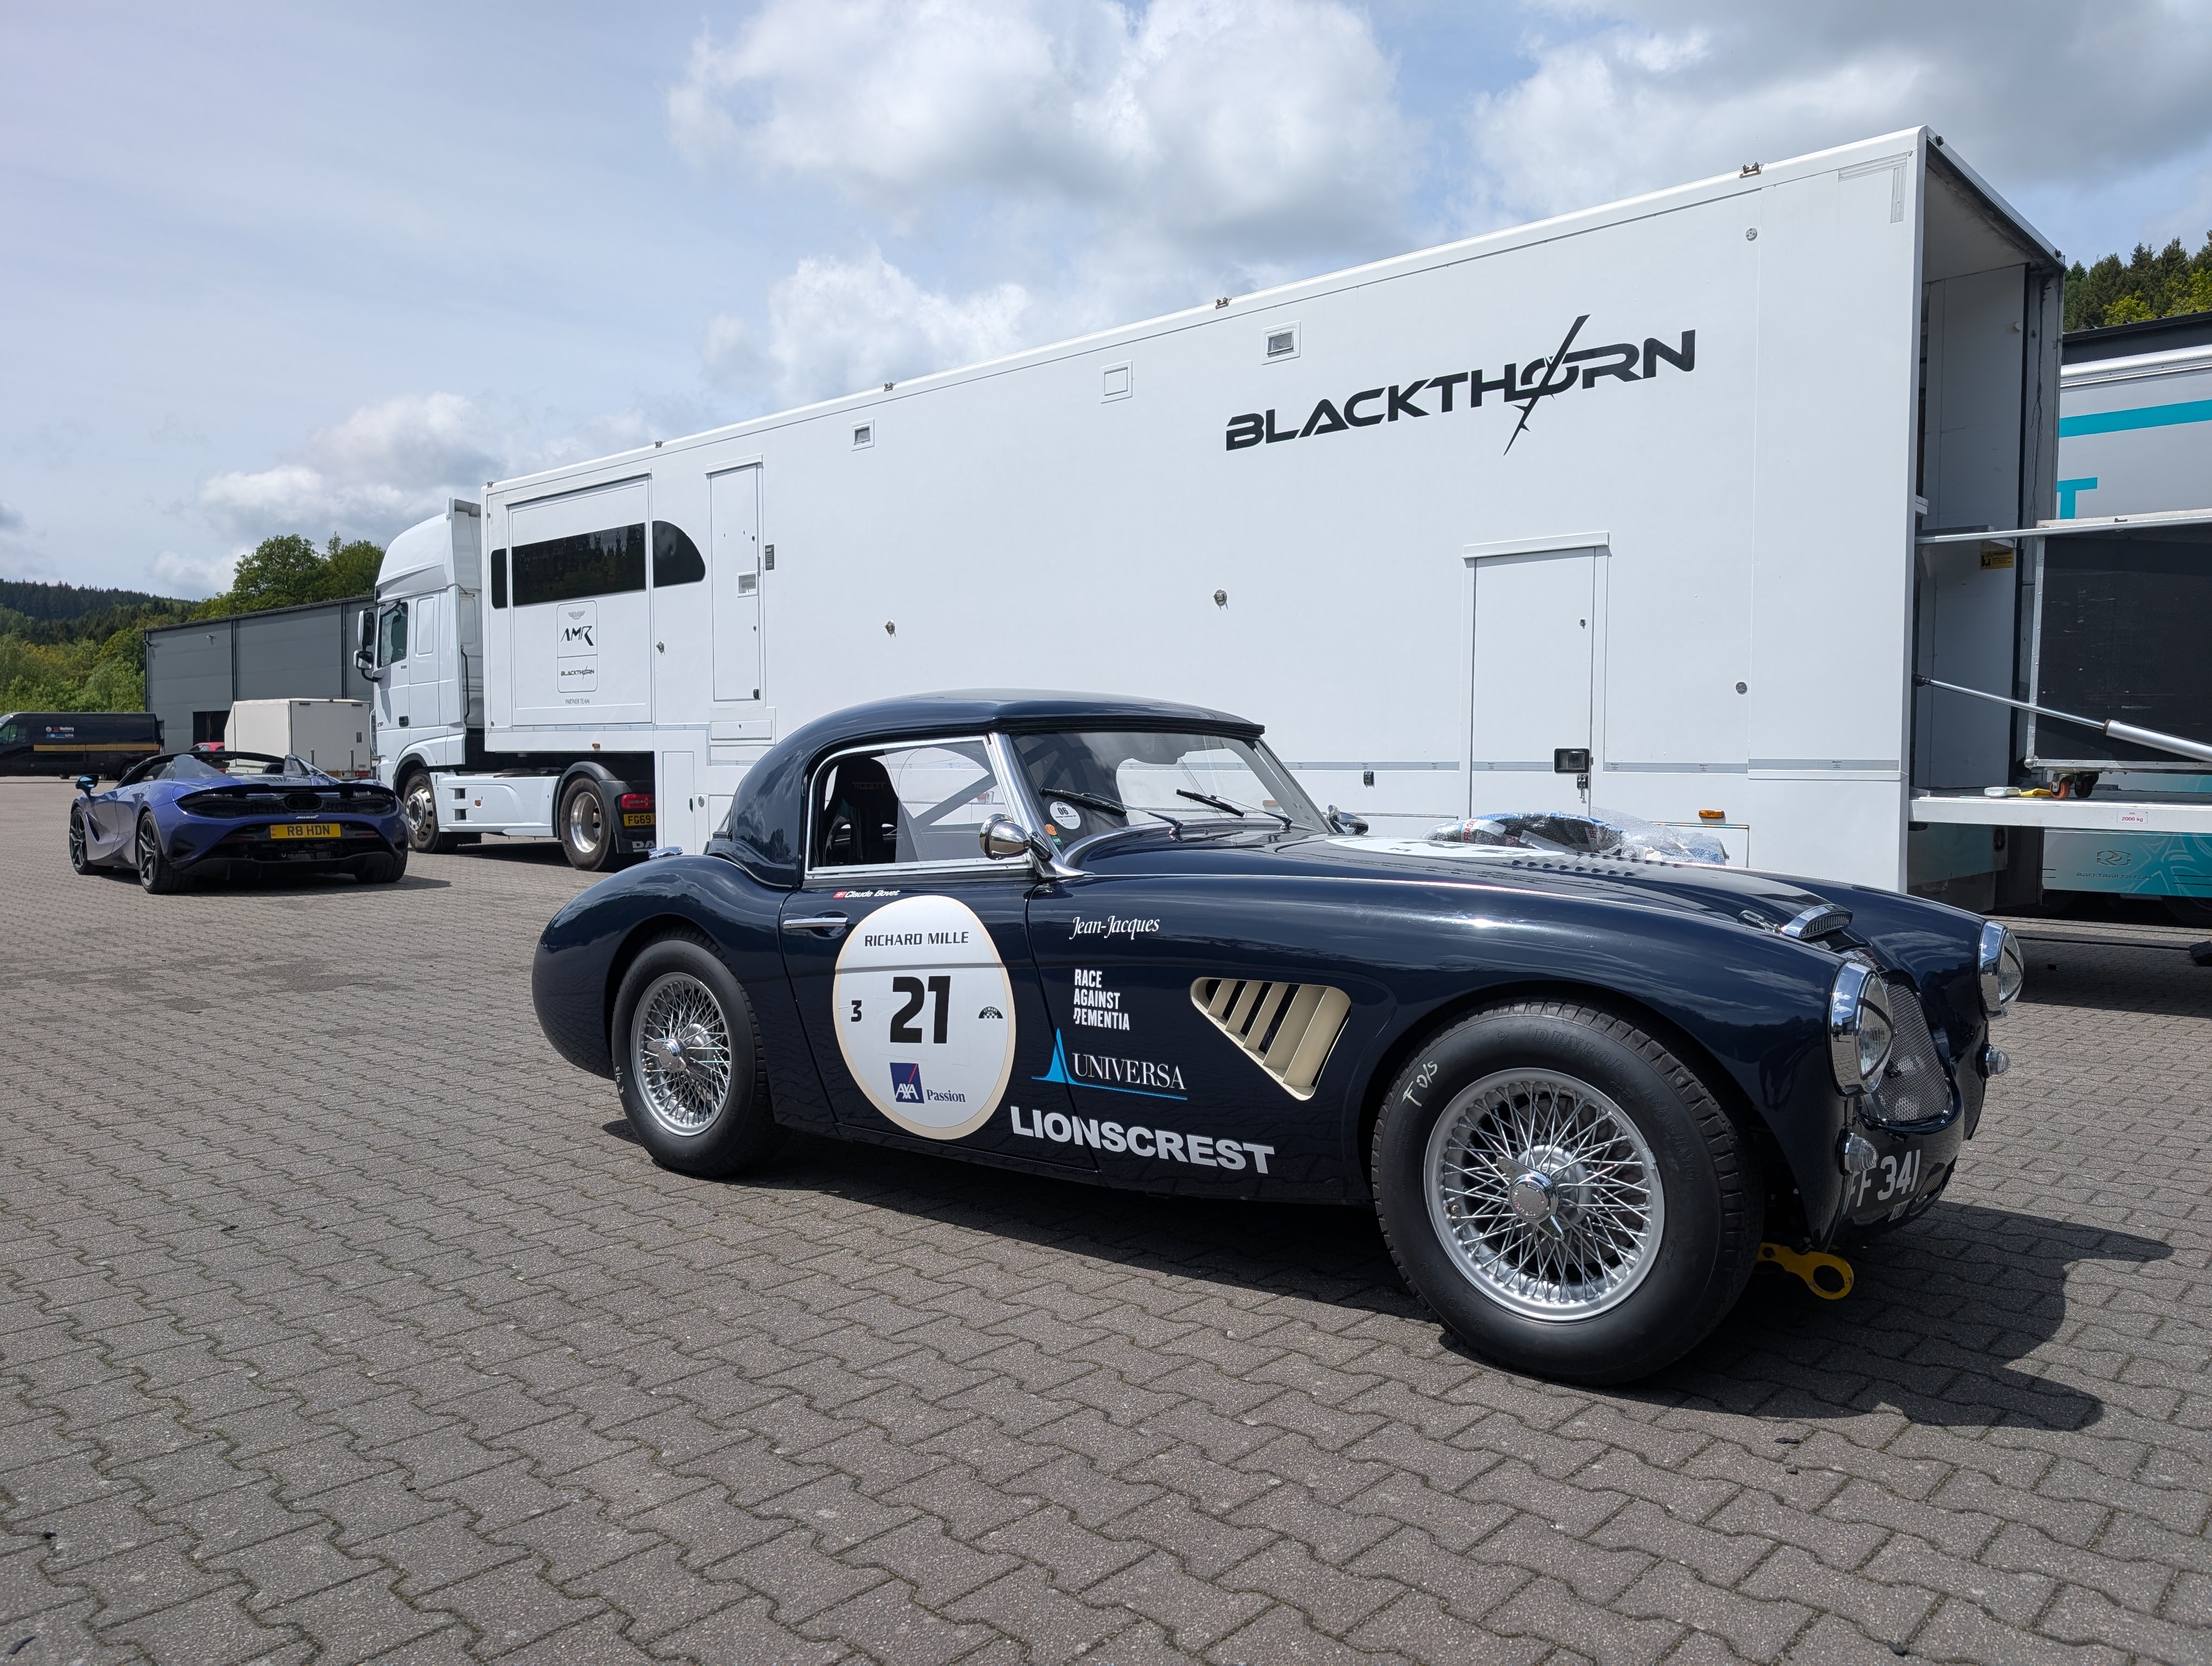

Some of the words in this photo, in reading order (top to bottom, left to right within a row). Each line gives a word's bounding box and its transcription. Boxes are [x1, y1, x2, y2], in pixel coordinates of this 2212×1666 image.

[1226, 316, 1696, 456] BLACKTHORN
[561, 625, 594, 646] AMR
[561, 667, 595, 678] BLACKTHORN
[628, 815, 651, 825] FG69
[1057, 807, 1069, 815] 06
[287, 826, 303, 836] R8
[306, 825, 330, 835] HDN
[1069, 915, 1160, 940] Jean-Jacques
[864, 933, 923, 947] RICHARD
[928, 931, 969, 945] MILLE
[1074, 968, 1103, 988] RACE
[890, 975, 951, 1044] 21
[1073, 988, 1121, 1010] AGAINST
[851, 999, 862, 1022] 3
[1073, 1007, 1130, 1031] DEMENTIA
[1533, 1028, 1628, 1071] DUNLOP
[1072, 1053, 1187, 1090] UNIVERSA
[895, 1083, 919, 1100] AXA
[926, 1089, 966, 1103] Passion
[1010, 1105, 1275, 1174] LIONSCREST
[1877, 1149, 1920, 1201] 341
